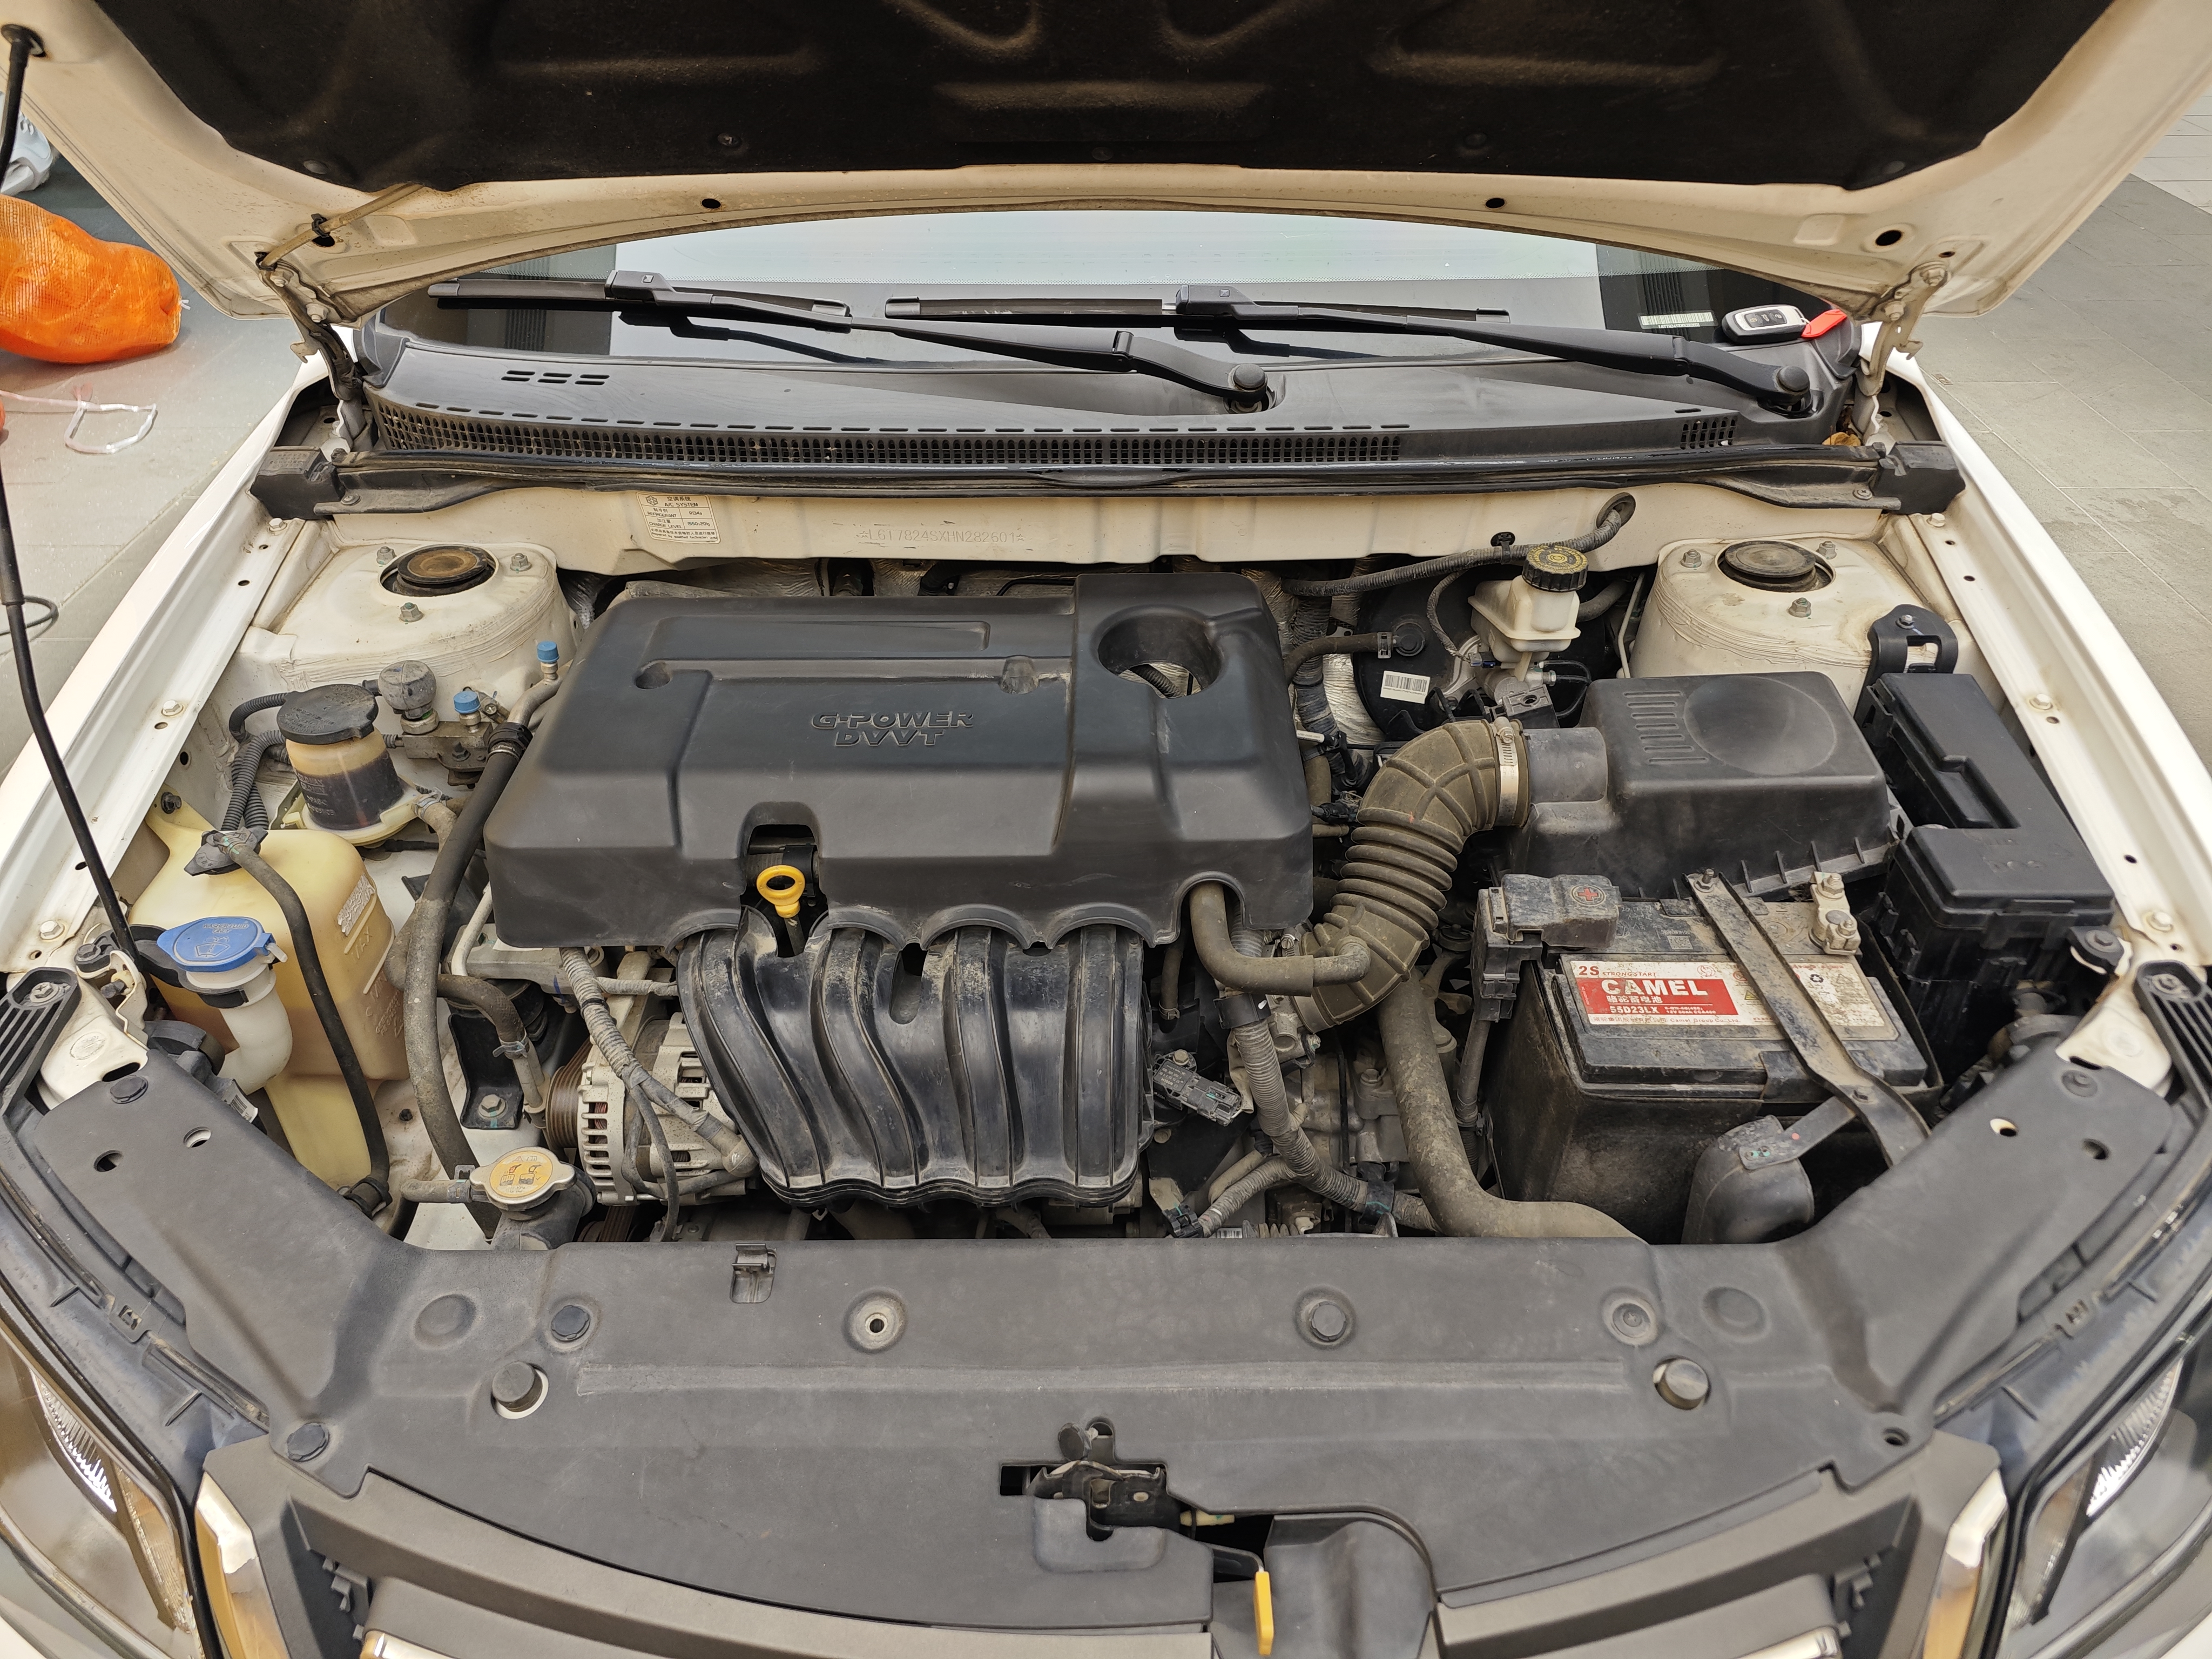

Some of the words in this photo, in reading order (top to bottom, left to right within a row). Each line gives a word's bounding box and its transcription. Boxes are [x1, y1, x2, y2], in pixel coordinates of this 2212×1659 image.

[811, 711, 974, 729] G-POWER
[835, 729, 944, 746] DVVT
[1579, 966, 1600, 976] 2S
[1601, 979, 1708, 995] CAMEL
[1606, 995, 1663, 1003] 骆驼蓄电池
[1609, 1006, 1660, 1014] 55D23LX
[1161, 1077, 1174, 1085] BOSCH
